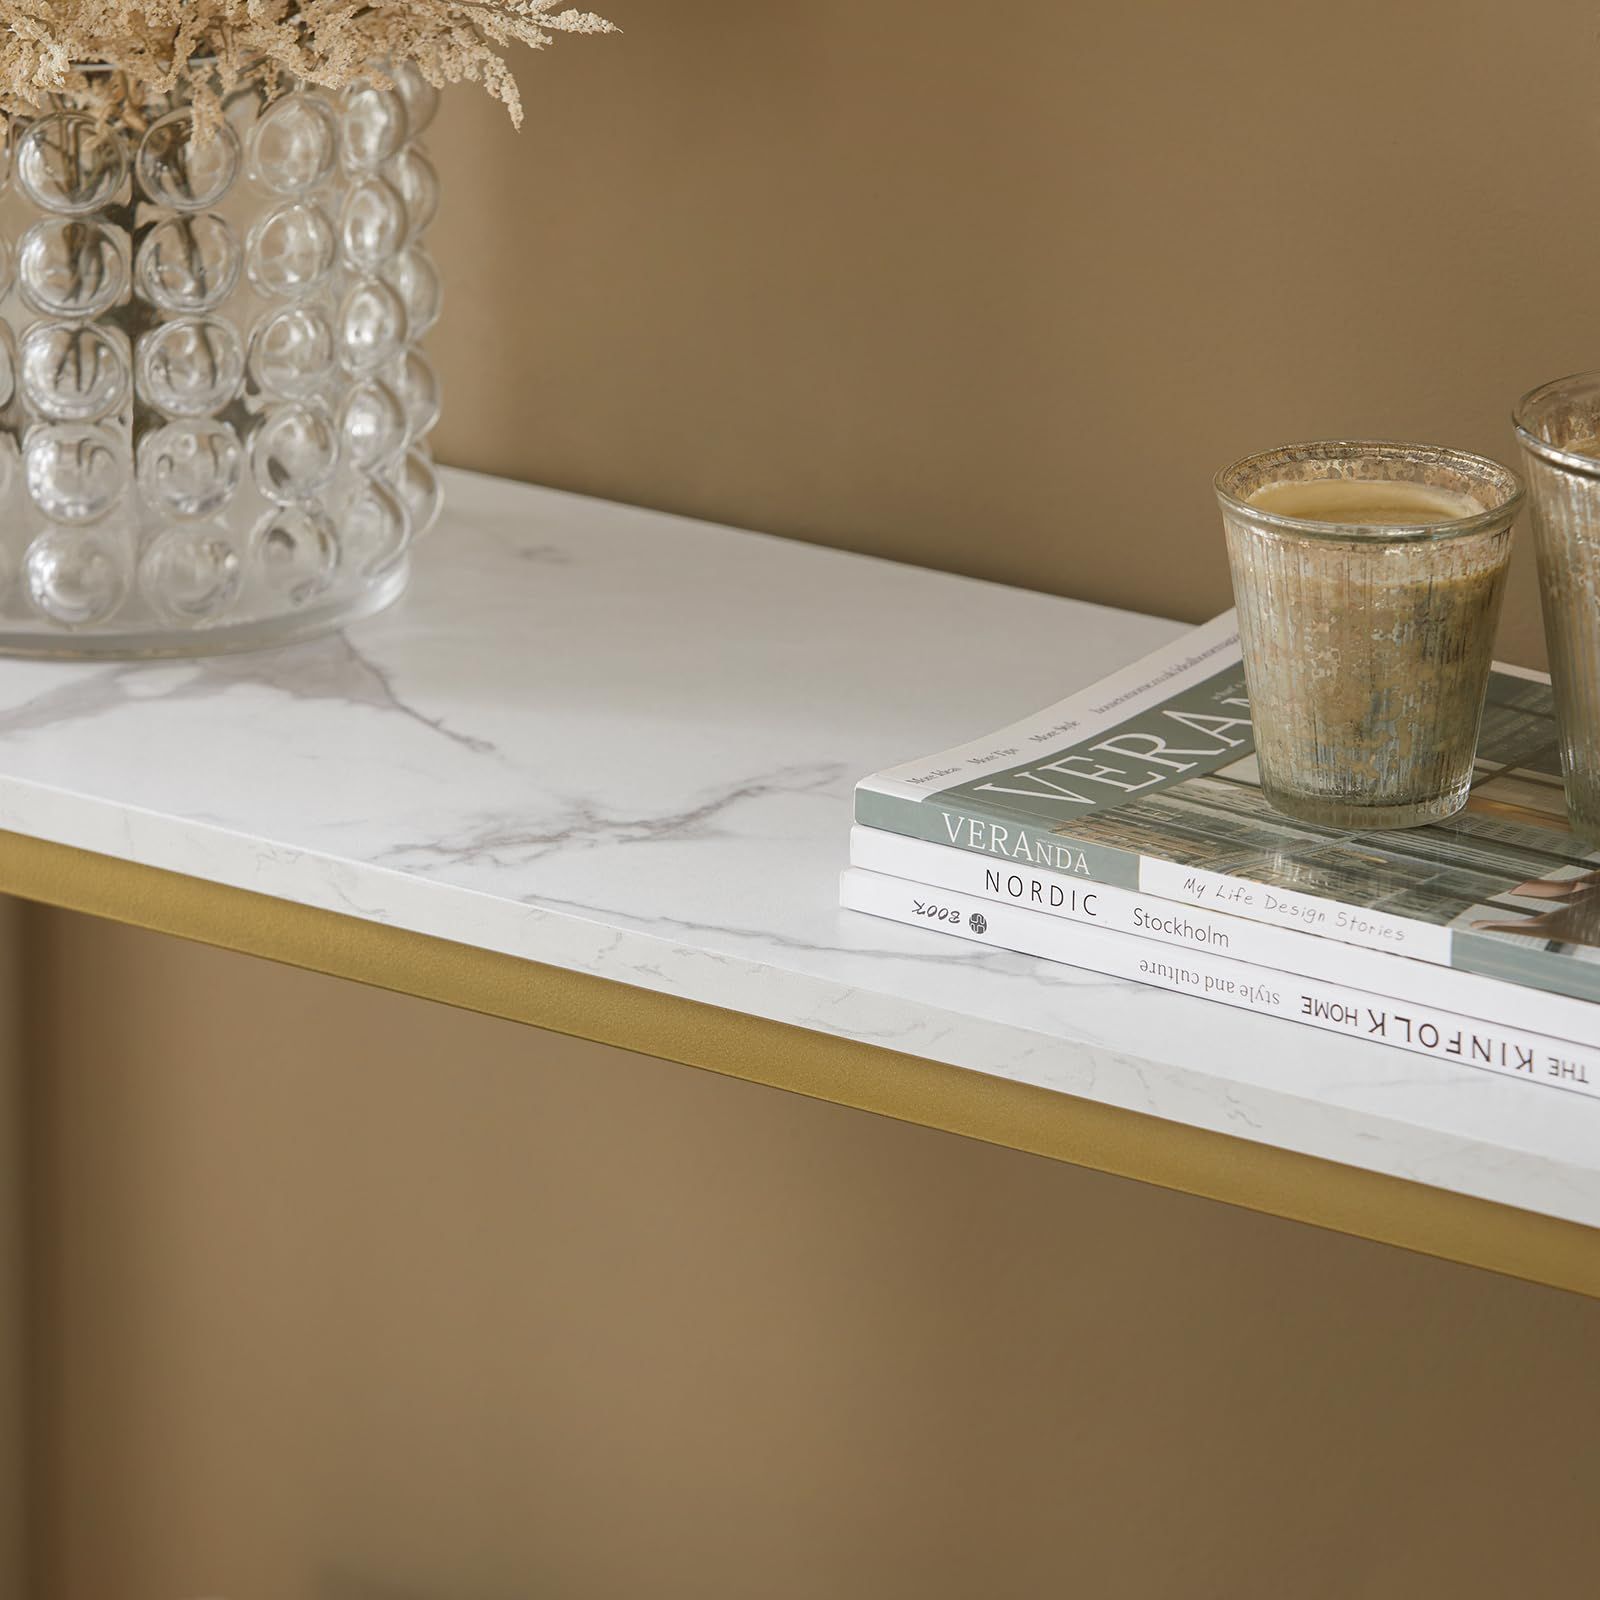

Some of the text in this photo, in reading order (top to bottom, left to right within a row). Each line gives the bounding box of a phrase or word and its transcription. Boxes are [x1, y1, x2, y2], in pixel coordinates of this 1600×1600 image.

[941, 811, 1091, 876] VERANDA
[911, 899, 961, 924] BOOK
[985, 868, 1098, 917] NORDIC
[1182, 877, 1406, 942] My Life Design Stories
[1132, 907, 1230, 948] Stockholm
[1138, 959, 1281, 1006] style and culture
[1300, 995, 1590, 1084] THE KINFOLK HOME
